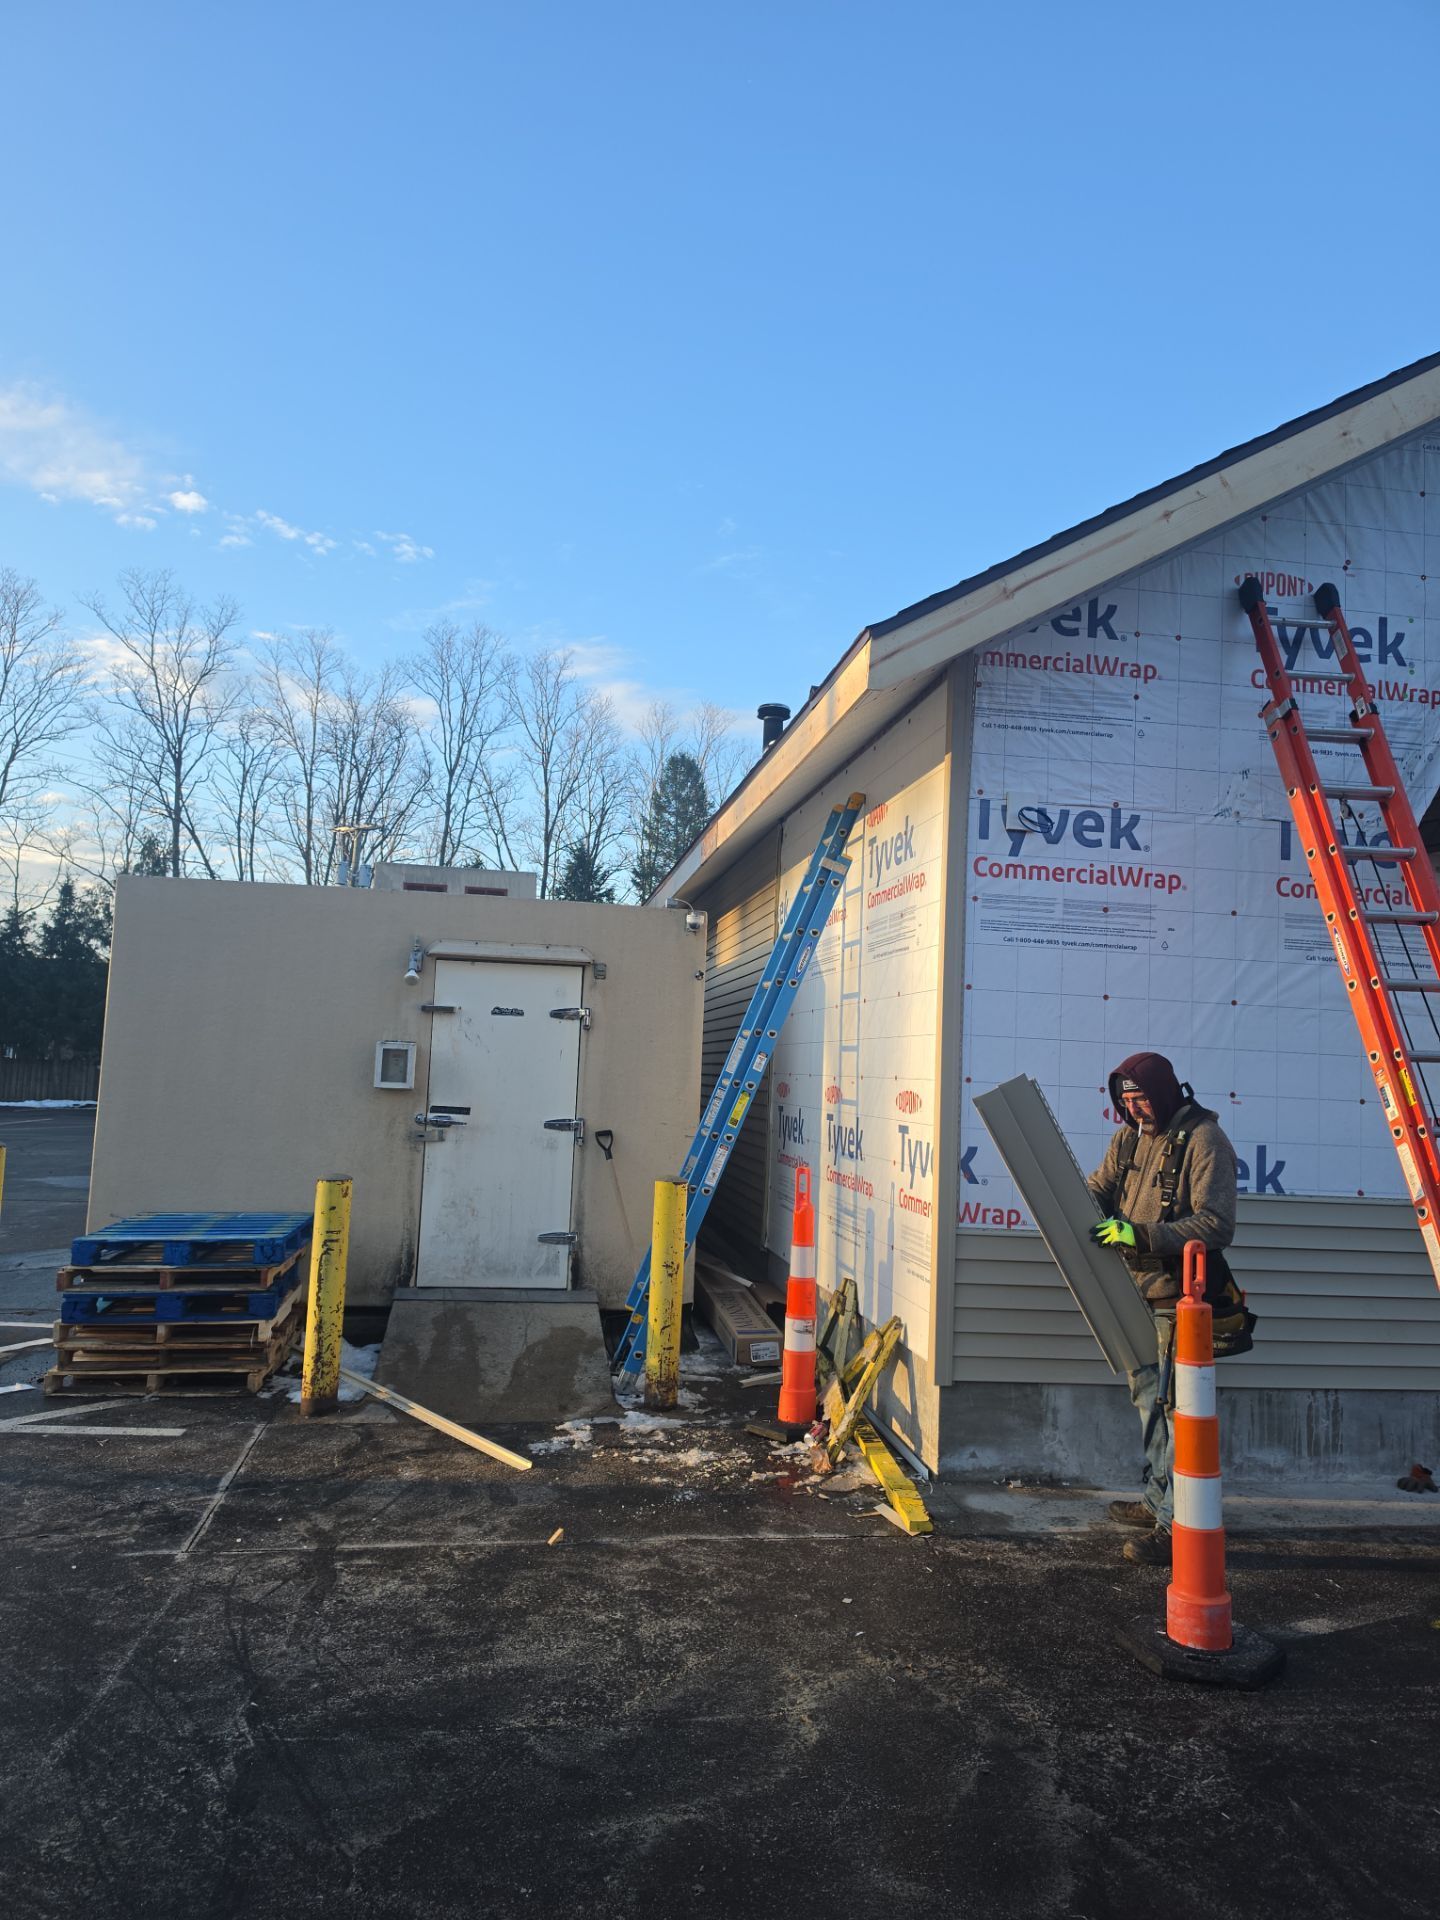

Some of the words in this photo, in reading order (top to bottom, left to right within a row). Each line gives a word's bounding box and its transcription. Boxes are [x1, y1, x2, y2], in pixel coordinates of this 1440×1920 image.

[1256, 607, 1407, 671] yvek
[976, 650, 1158, 685] mmercialWrap
[868, 815, 915, 888] Tyvek
[867, 872, 926, 909] CommercialWrap
[973, 856, 1182, 894] CommercialWrap
[897, 1091, 921, 1115] DUPONT
[777, 1105, 804, 1150] Tyvek
[827, 1113, 863, 1166] Tyvek
[898, 1124, 933, 1190] Tyv
[826, 1165, 873, 1200] CommercialWrap
[899, 1187, 932, 1219] Commer
